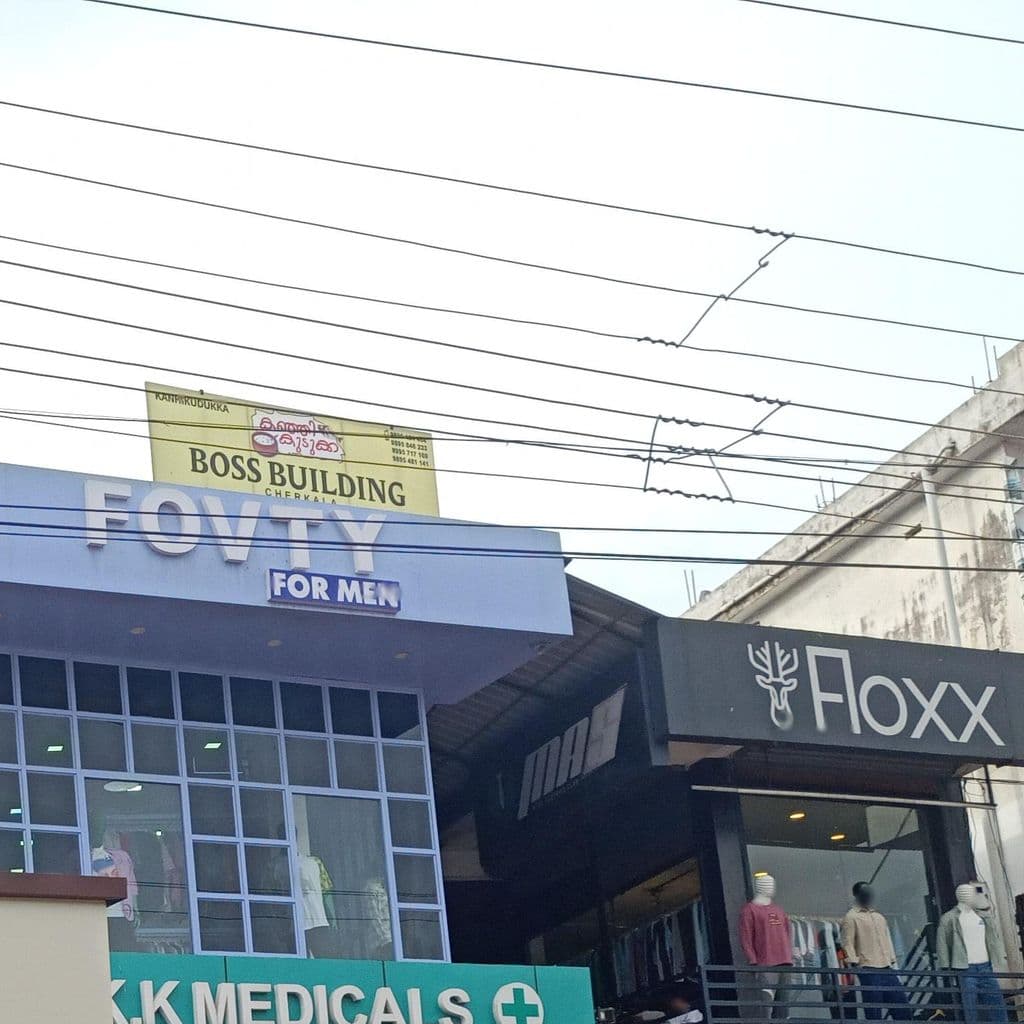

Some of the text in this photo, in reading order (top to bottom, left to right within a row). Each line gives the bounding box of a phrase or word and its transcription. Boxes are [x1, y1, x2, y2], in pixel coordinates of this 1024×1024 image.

[189, 448, 406, 507] BOSS BUILDING
[84, 479, 387, 575] FOVTY
[272, 572, 400, 609] FOR MEN
